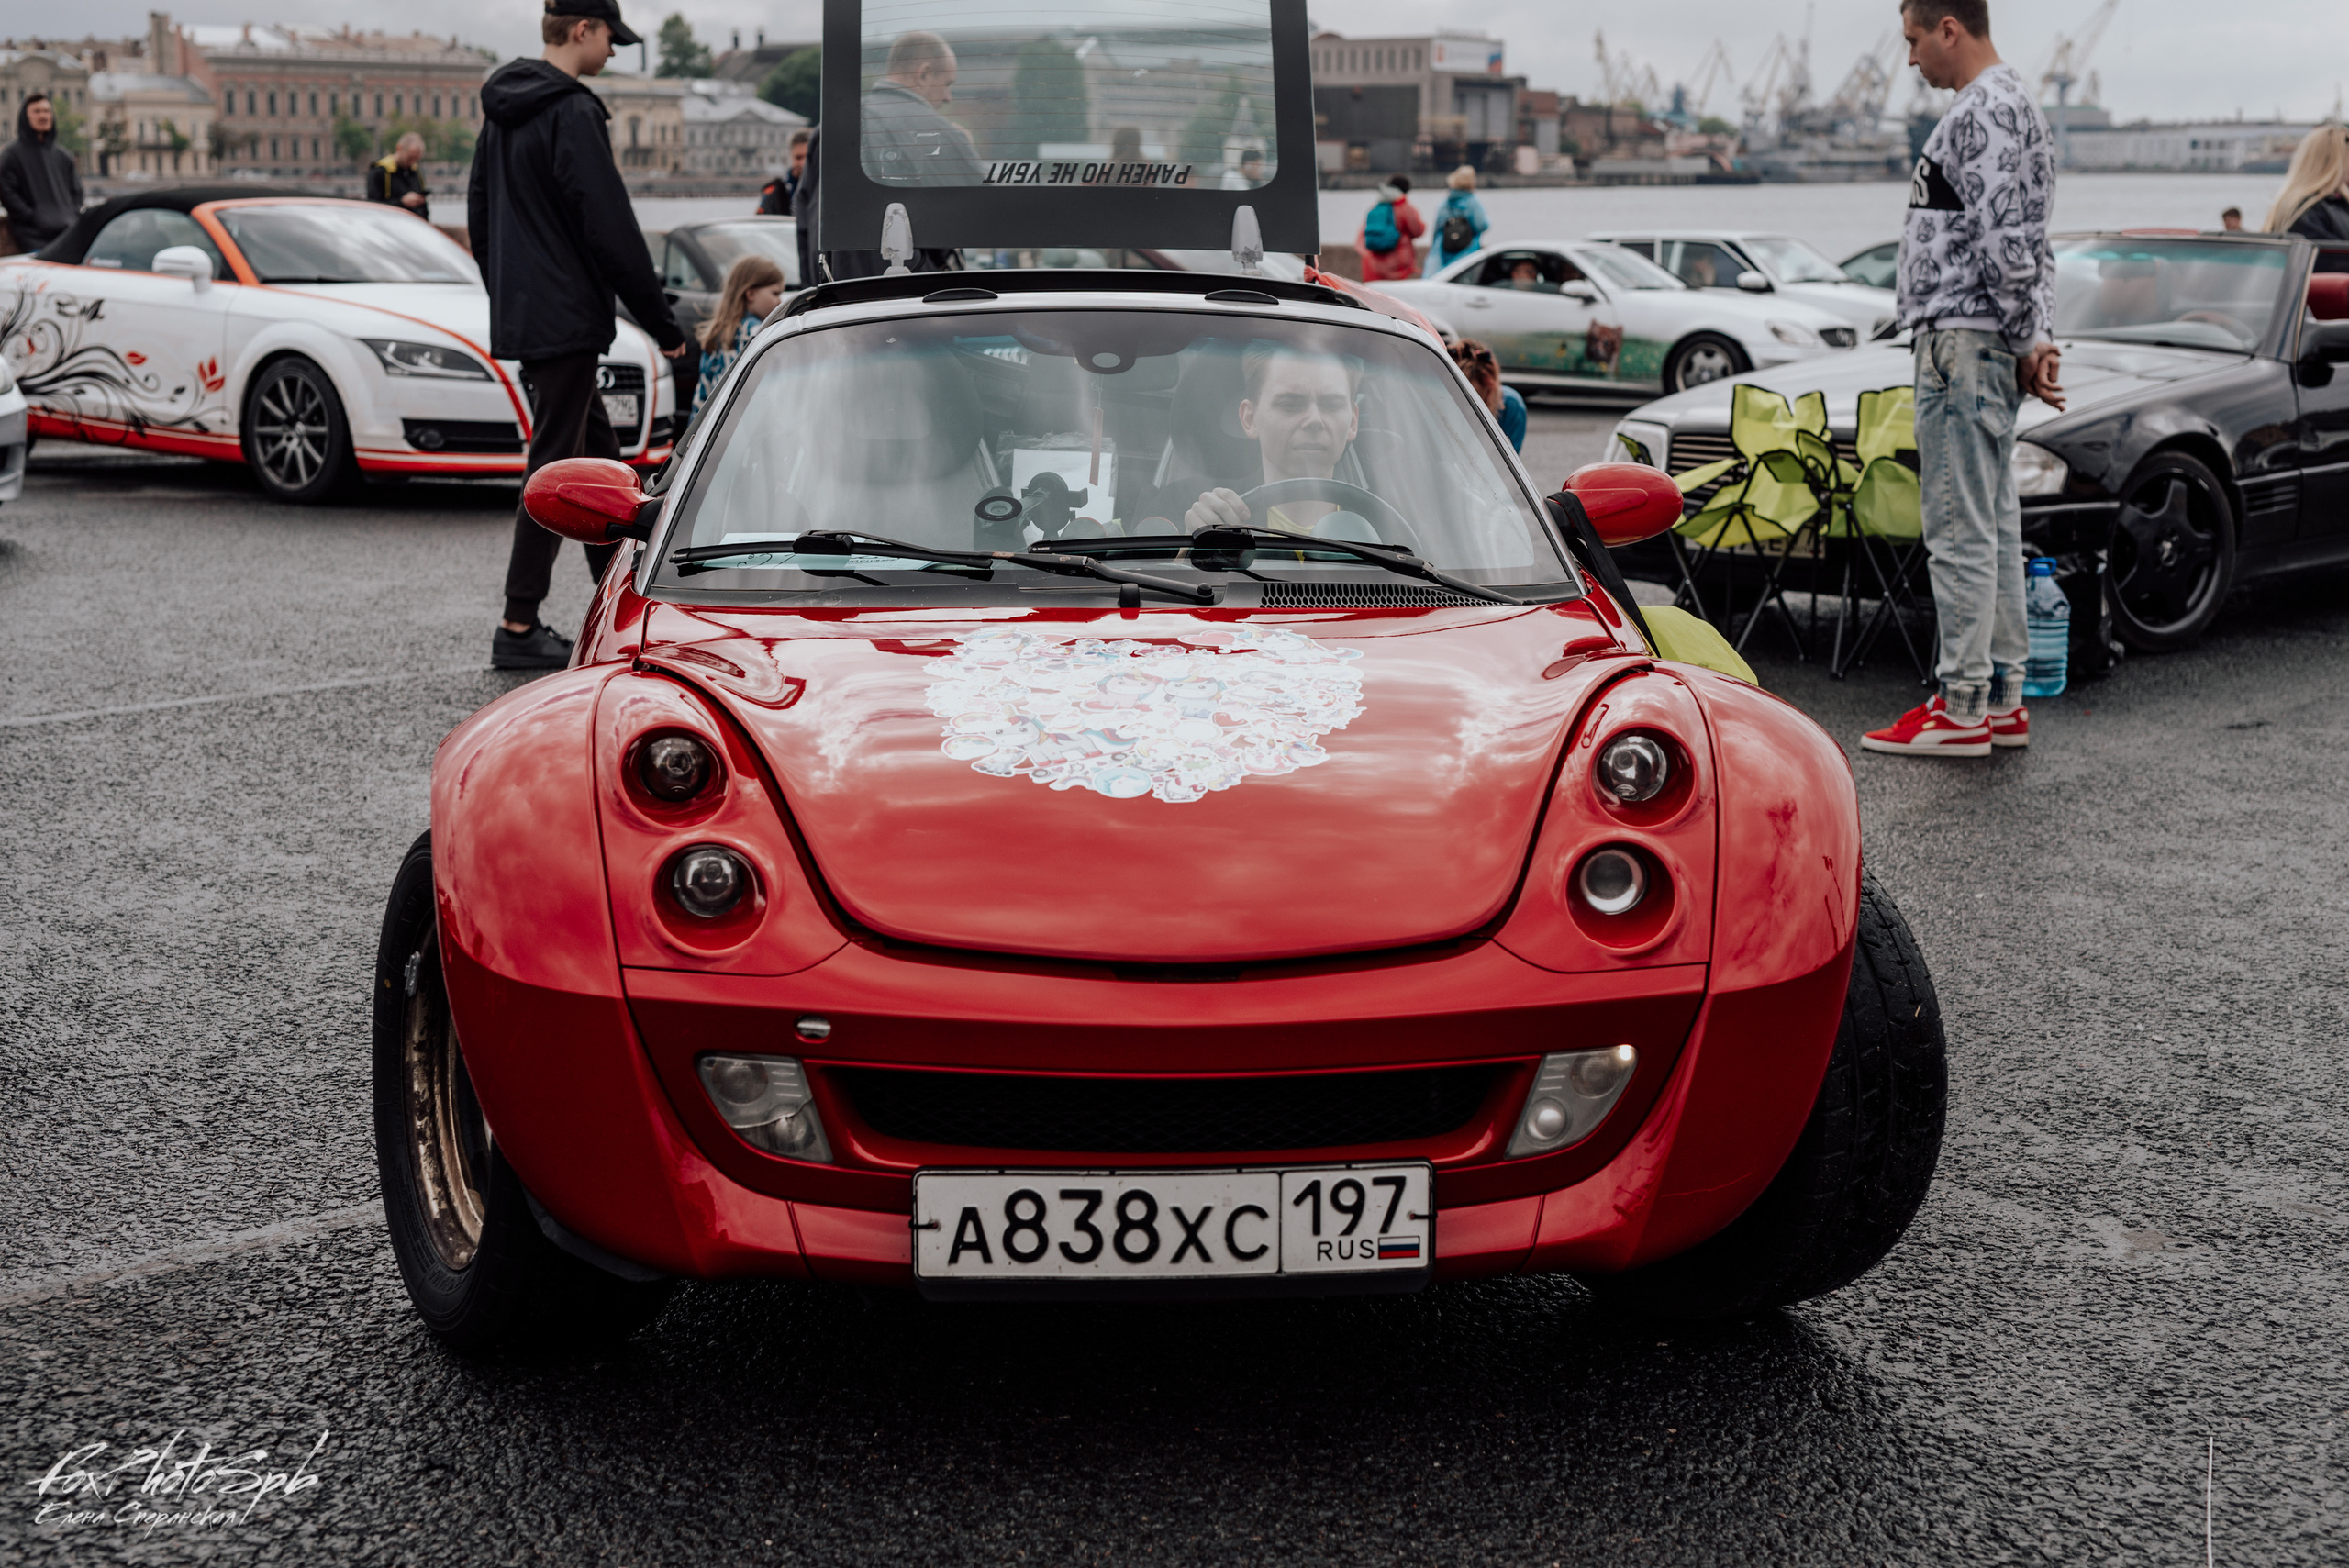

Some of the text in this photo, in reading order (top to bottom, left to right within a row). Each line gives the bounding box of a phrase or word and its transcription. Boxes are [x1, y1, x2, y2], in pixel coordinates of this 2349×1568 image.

[982, 162, 1193, 185] РАНЕН НО НЕ УБИТ
[1293, 1176, 1407, 1237] 197
[1317, 1239, 1375, 1262] RUS
